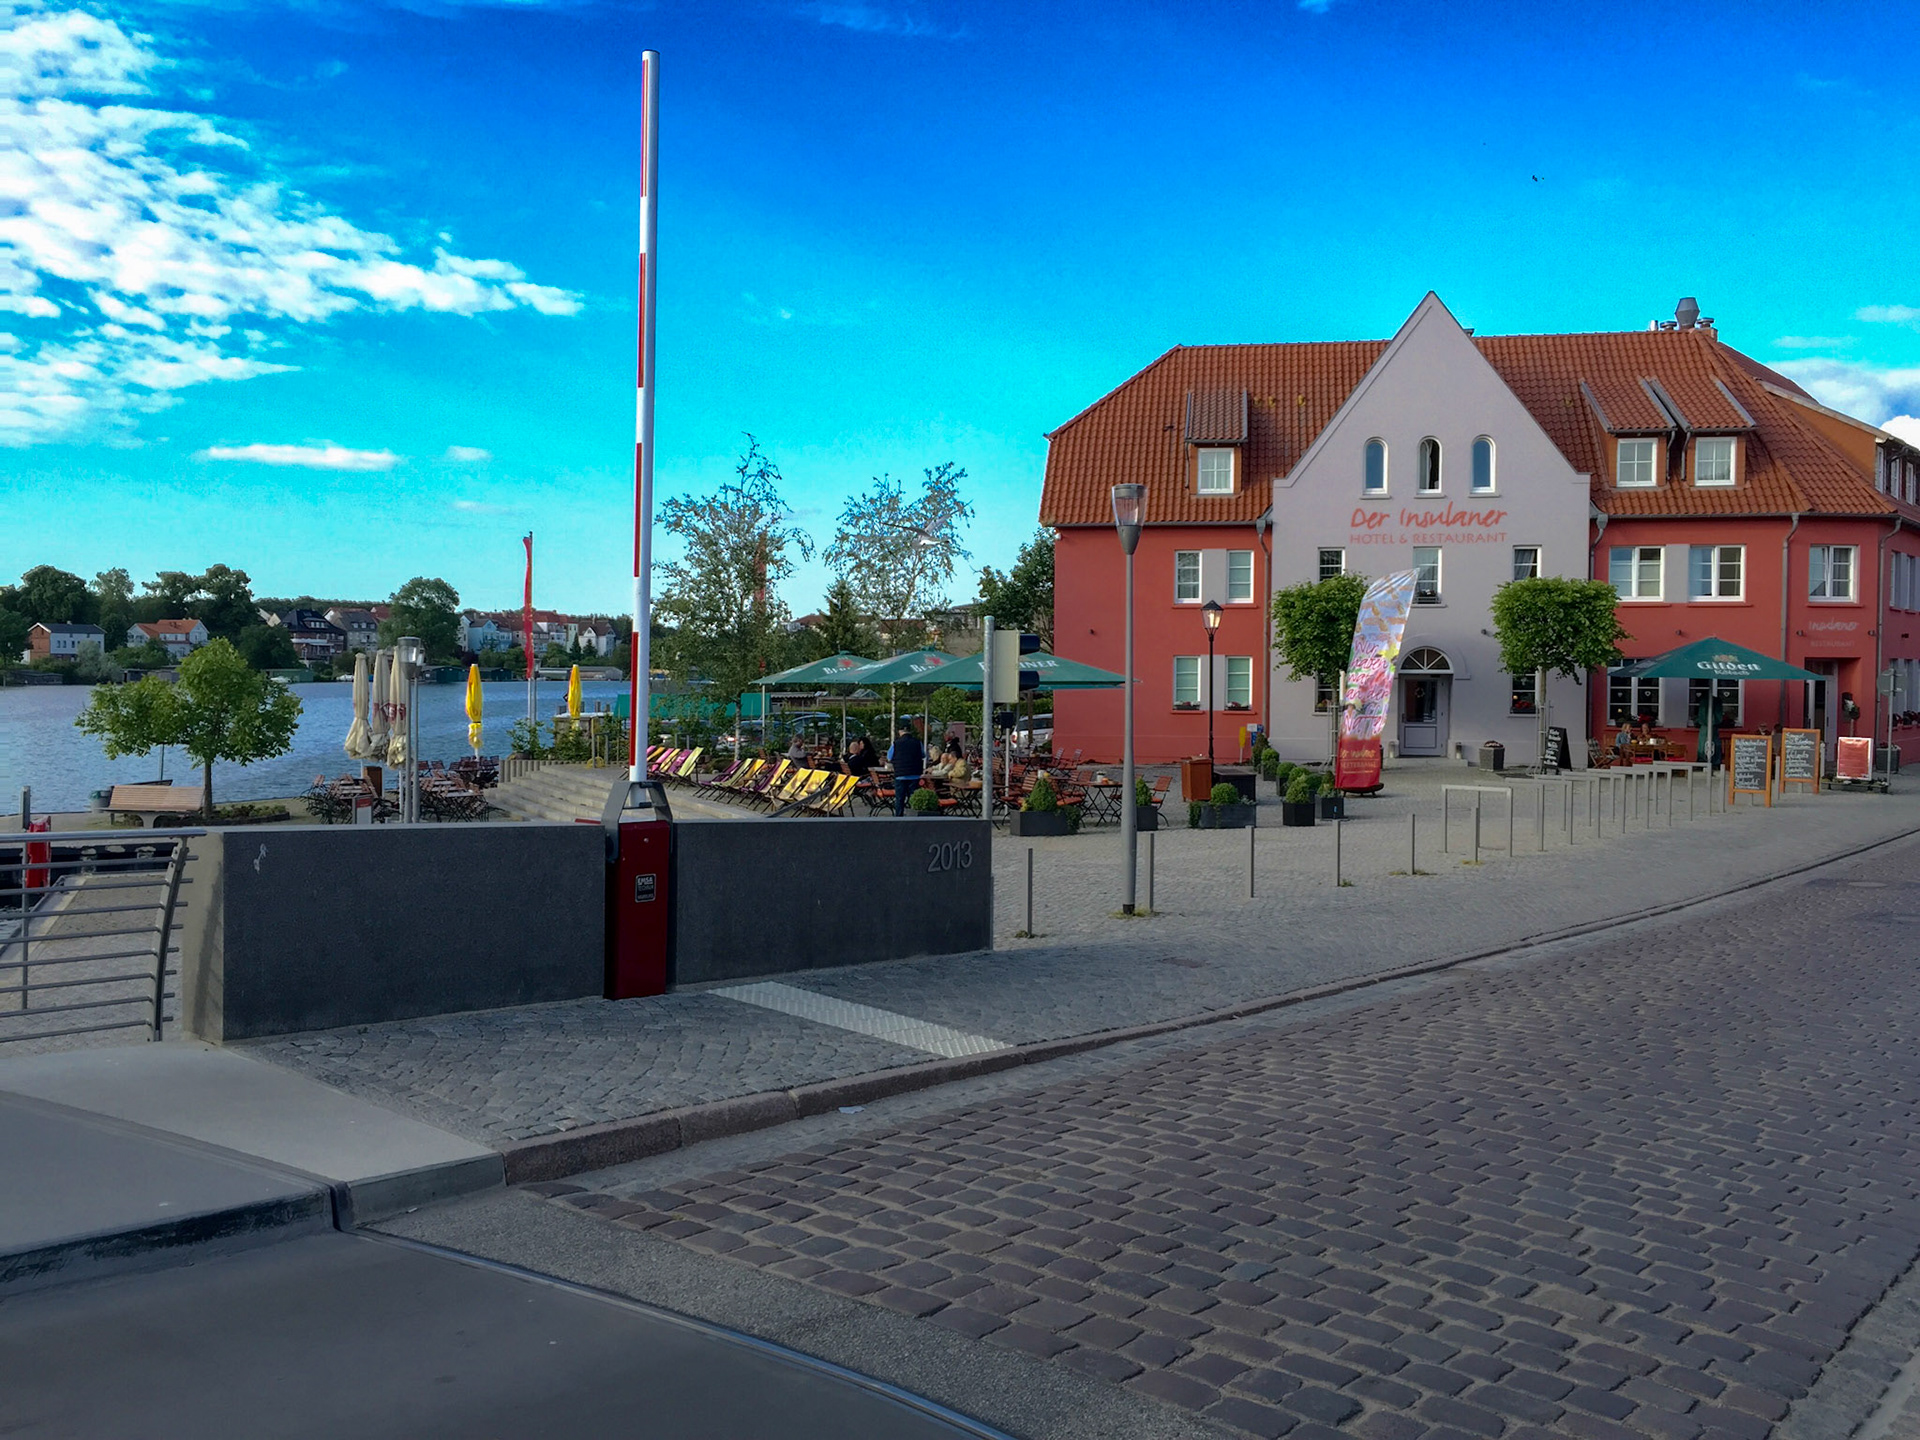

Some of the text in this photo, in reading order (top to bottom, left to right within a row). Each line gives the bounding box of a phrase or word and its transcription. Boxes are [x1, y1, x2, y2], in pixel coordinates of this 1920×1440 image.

[1350, 501, 1508, 529] Der Insulaner
[1350, 532, 1508, 545] HOTEL & RESTAURANT
[1696, 661, 1762, 671] Gilden
[928, 840, 973, 872] 2013
